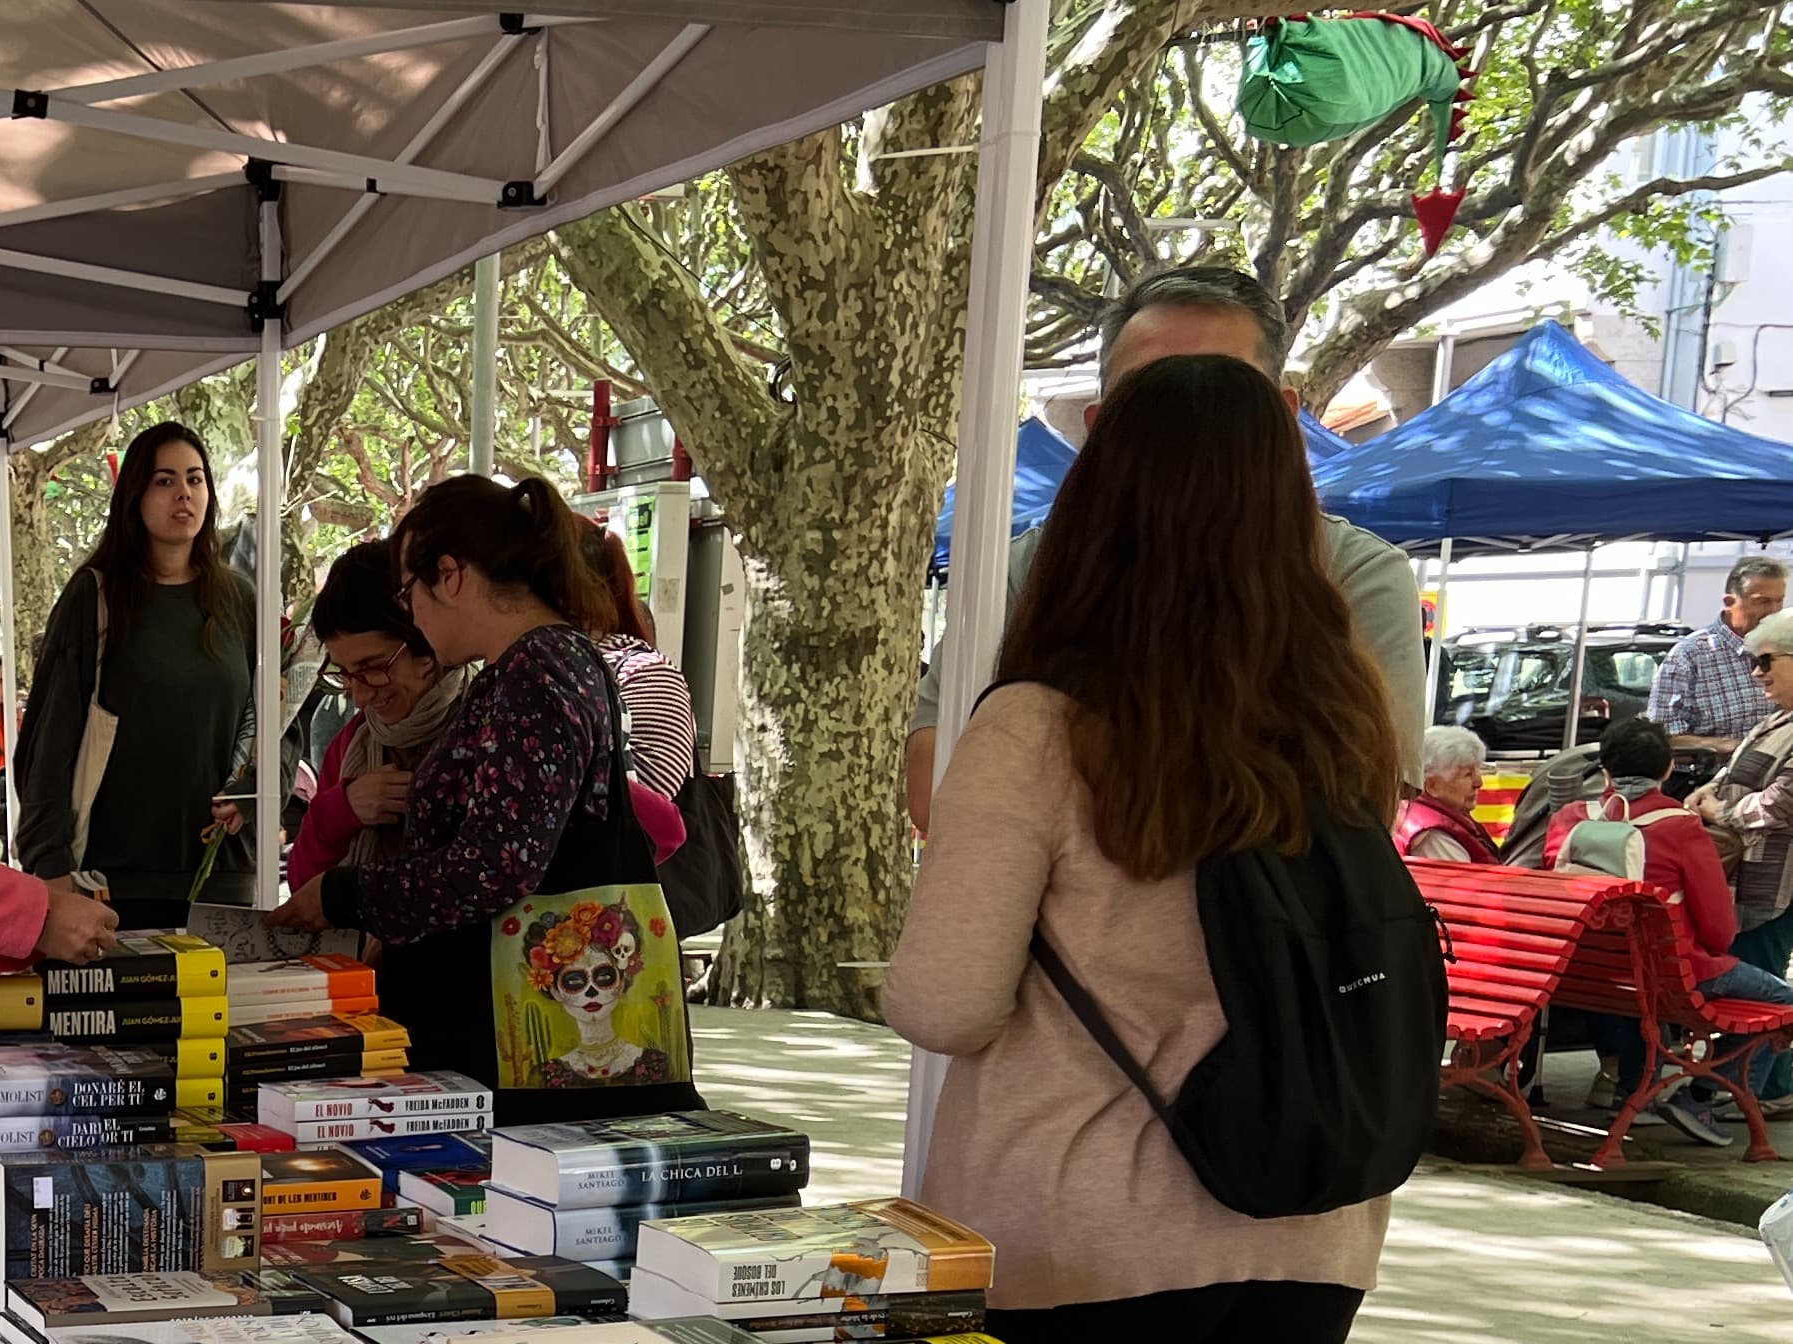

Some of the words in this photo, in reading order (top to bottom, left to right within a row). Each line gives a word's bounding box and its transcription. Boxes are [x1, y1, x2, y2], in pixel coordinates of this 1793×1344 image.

[47, 968, 114, 995] MENTIRA
[73, 1079, 125, 1096] DONARÉ
[128, 1080, 145, 1094] EL
[0, 1090, 45, 1104] MOLIST
[641, 1171, 657, 1183] LA
[660, 1168, 703, 1182] CHICA
[706, 1167, 730, 1179] DEL
[578, 1179, 625, 1190] SANTIAGO
